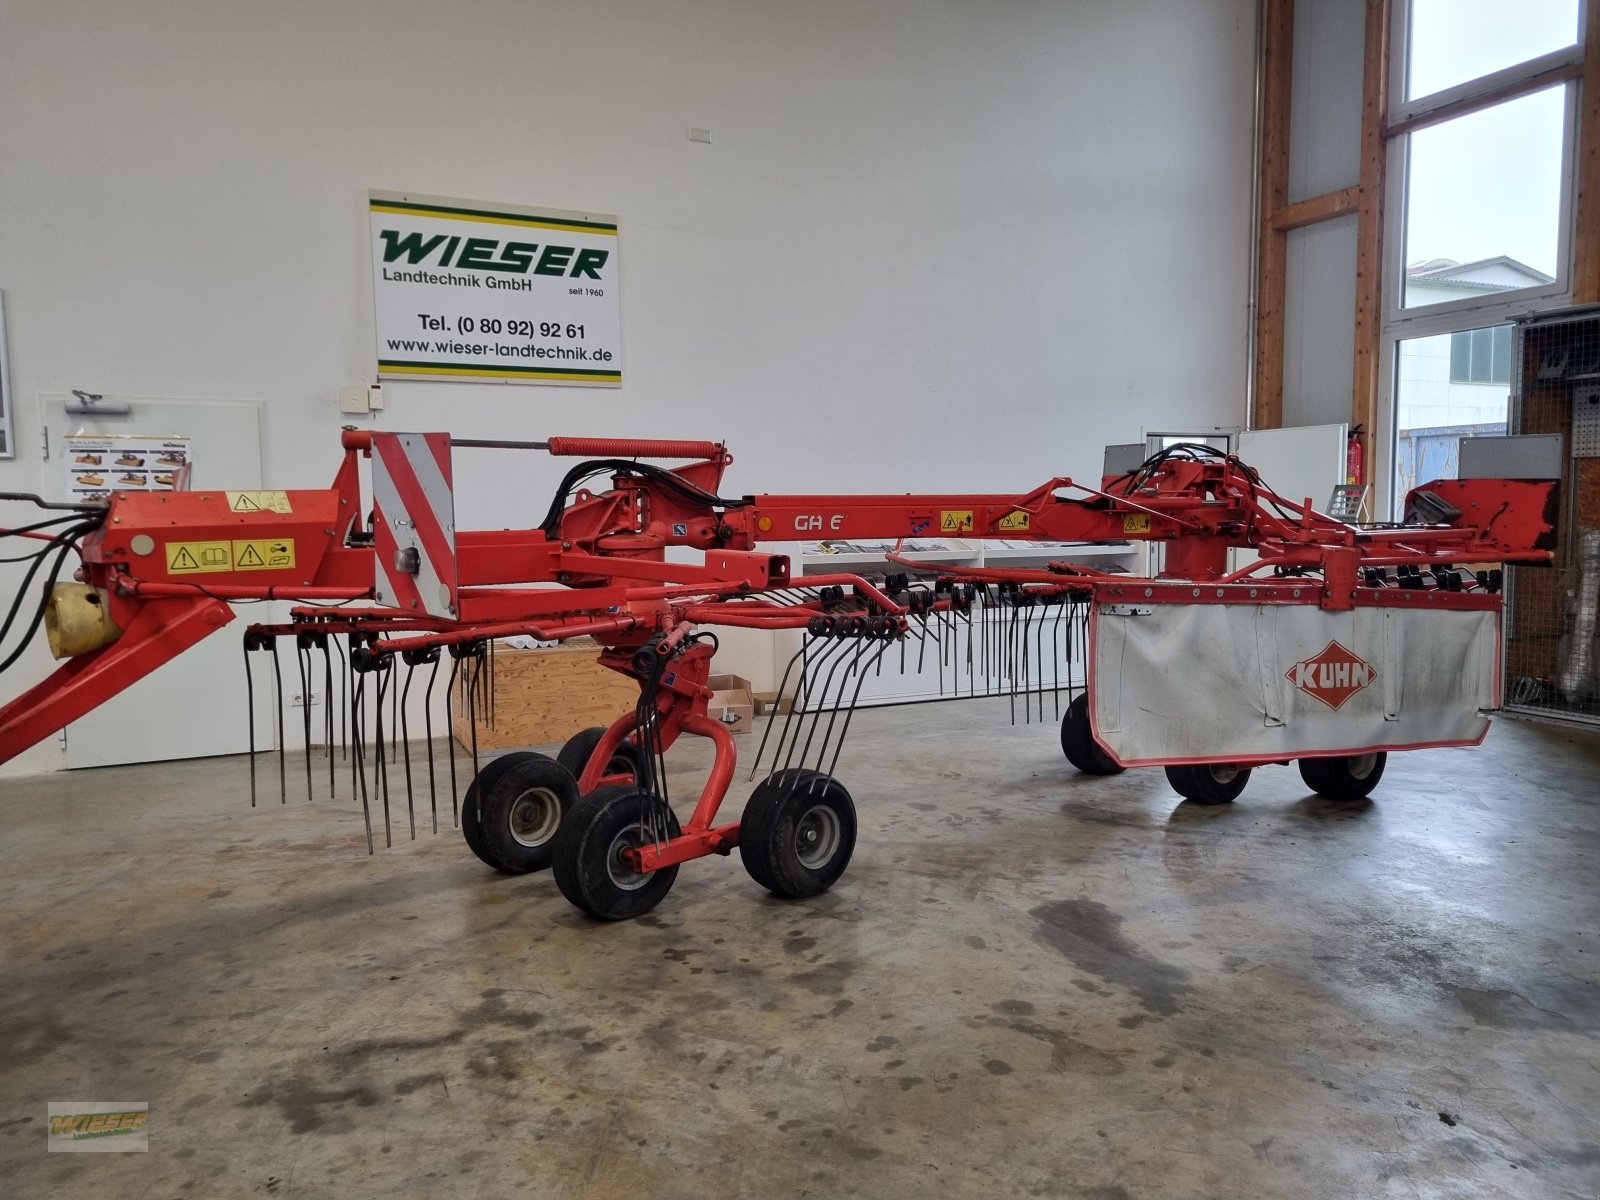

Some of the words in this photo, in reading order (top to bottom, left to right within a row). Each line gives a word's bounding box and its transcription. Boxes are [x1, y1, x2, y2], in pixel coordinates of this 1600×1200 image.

[379, 229, 609, 280] WIESER
[382, 267, 481, 288] Landtechnik
[485, 276, 532, 291] GmbH
[568, 287, 583, 296] seit
[585, 288, 604, 297] 1960
[418, 314, 451, 331] Tel.
[457, 316, 474, 336] (0
[480, 318, 502, 334] 80
[507, 320, 534, 339] 92)
[540, 322, 561, 338] 92
[566, 324, 585, 339] 61
[387, 339, 613, 362] www.wieser-landtechnik.de
[1295, 662, 1369, 689] KUHN
